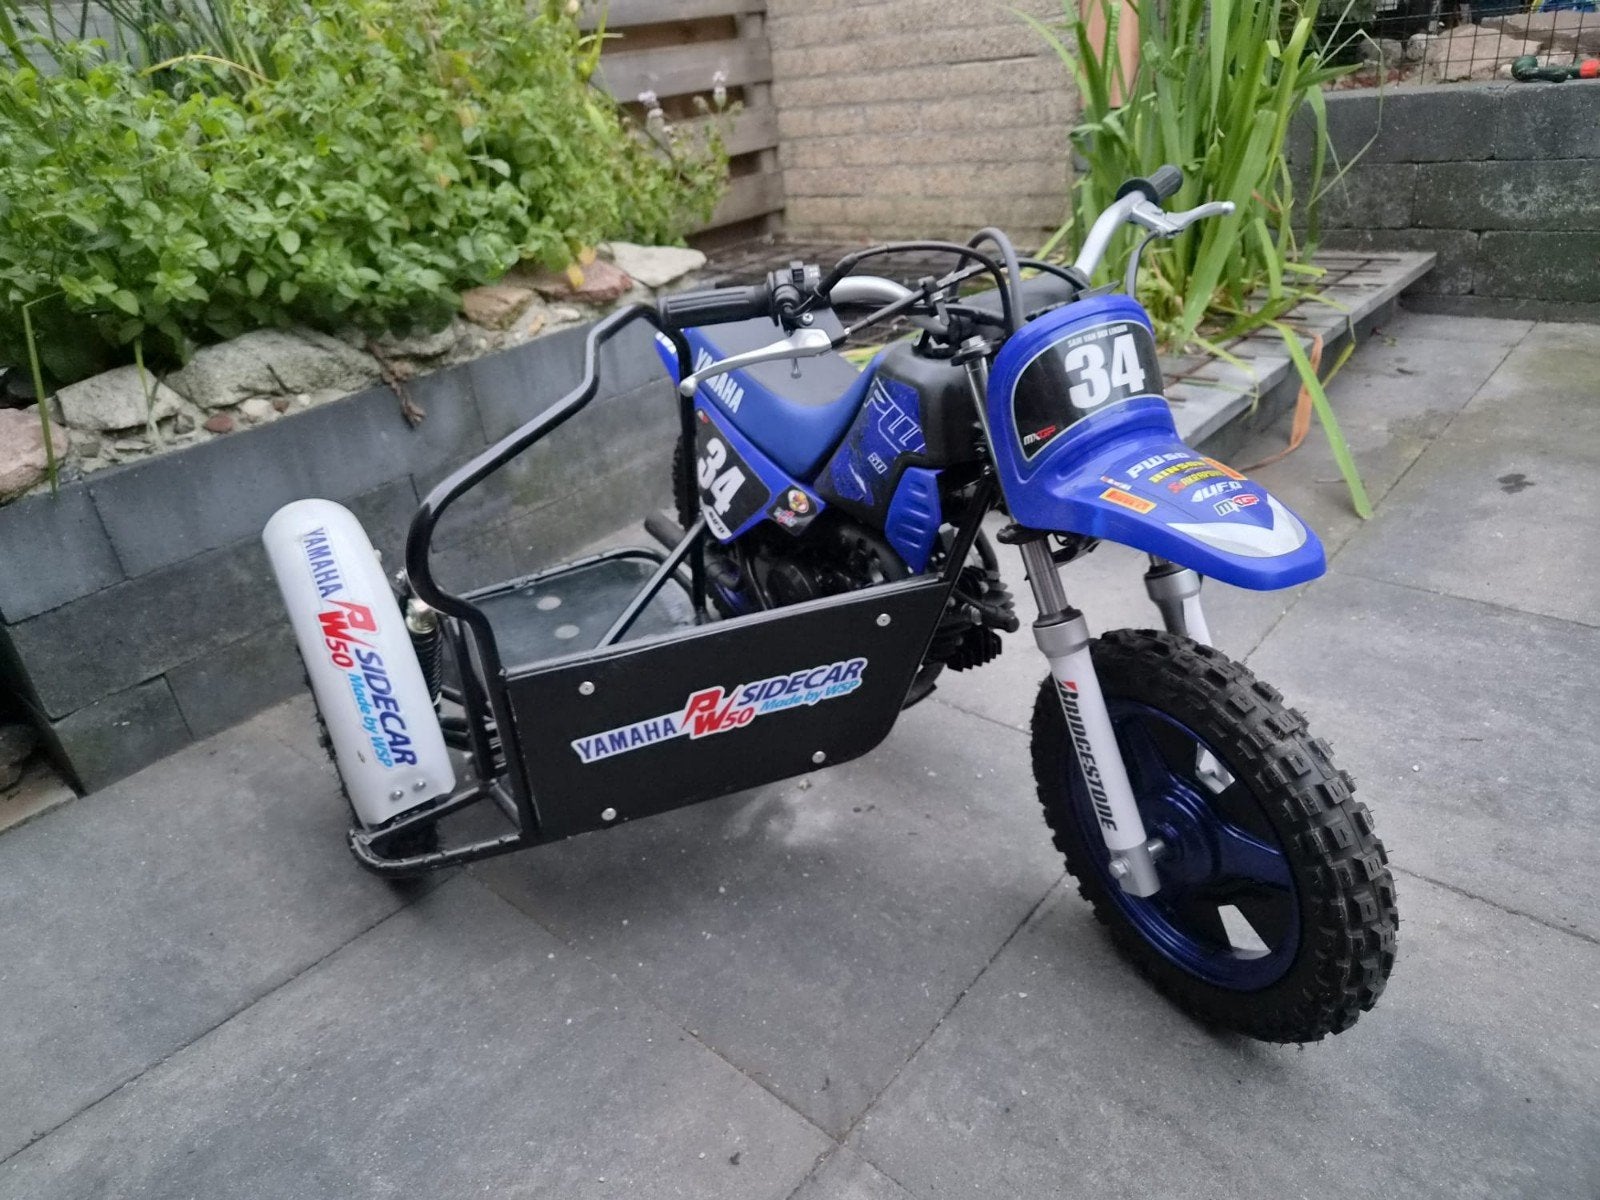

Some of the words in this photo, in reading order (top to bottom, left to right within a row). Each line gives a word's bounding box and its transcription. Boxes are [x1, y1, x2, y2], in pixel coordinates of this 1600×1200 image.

[1064, 333, 1146, 409] 34
[696, 437, 746, 516] 34
[303, 527, 344, 599] YAMAHA
[355, 648, 417, 766] SIDECAR
[348, 673, 371, 715] Made
[362, 716, 379, 736] by
[577, 718, 677, 760] YAMAHA
[737, 660, 865, 706] SIDECAR
[761, 693, 803, 711] Made
[804, 690, 822, 703] by
[825, 680, 860, 696] WSP
[370, 735, 393, 768] WSP
[1058, 680, 1118, 832] BRIDGESTONE
